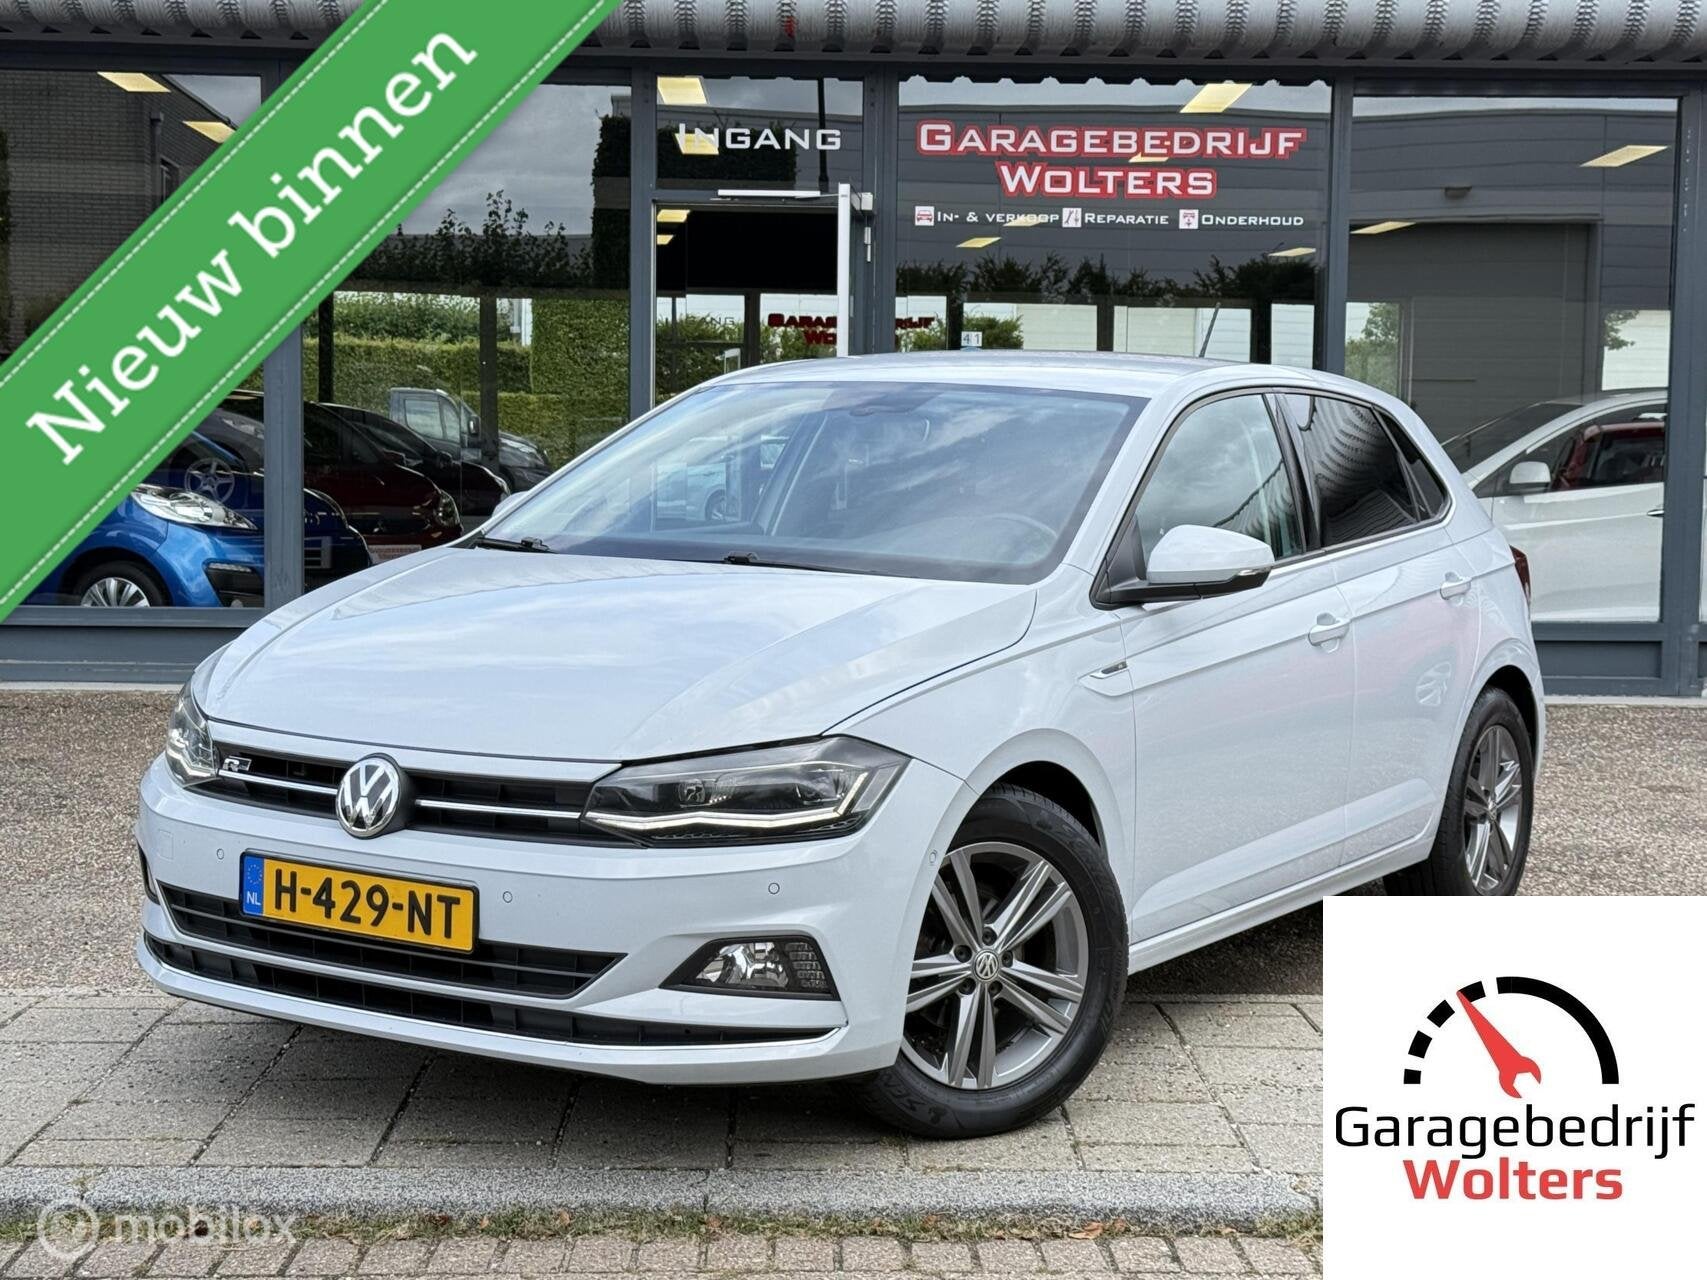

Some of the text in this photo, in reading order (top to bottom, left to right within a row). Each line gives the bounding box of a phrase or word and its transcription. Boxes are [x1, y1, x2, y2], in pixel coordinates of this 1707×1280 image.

[918, 121, 1306, 157] GARAGEBEDRIJF
[998, 163, 1215, 197] WOLTERS
[966, 211, 979, 223] &
[1084, 212, 1169, 225] REPARATIE
[1201, 214, 1304, 227] ONDERHOUD
[963, 333, 980, 345] 41
[246, 892, 261, 906] NL
[275, 868, 461, 939] H-429-NT
